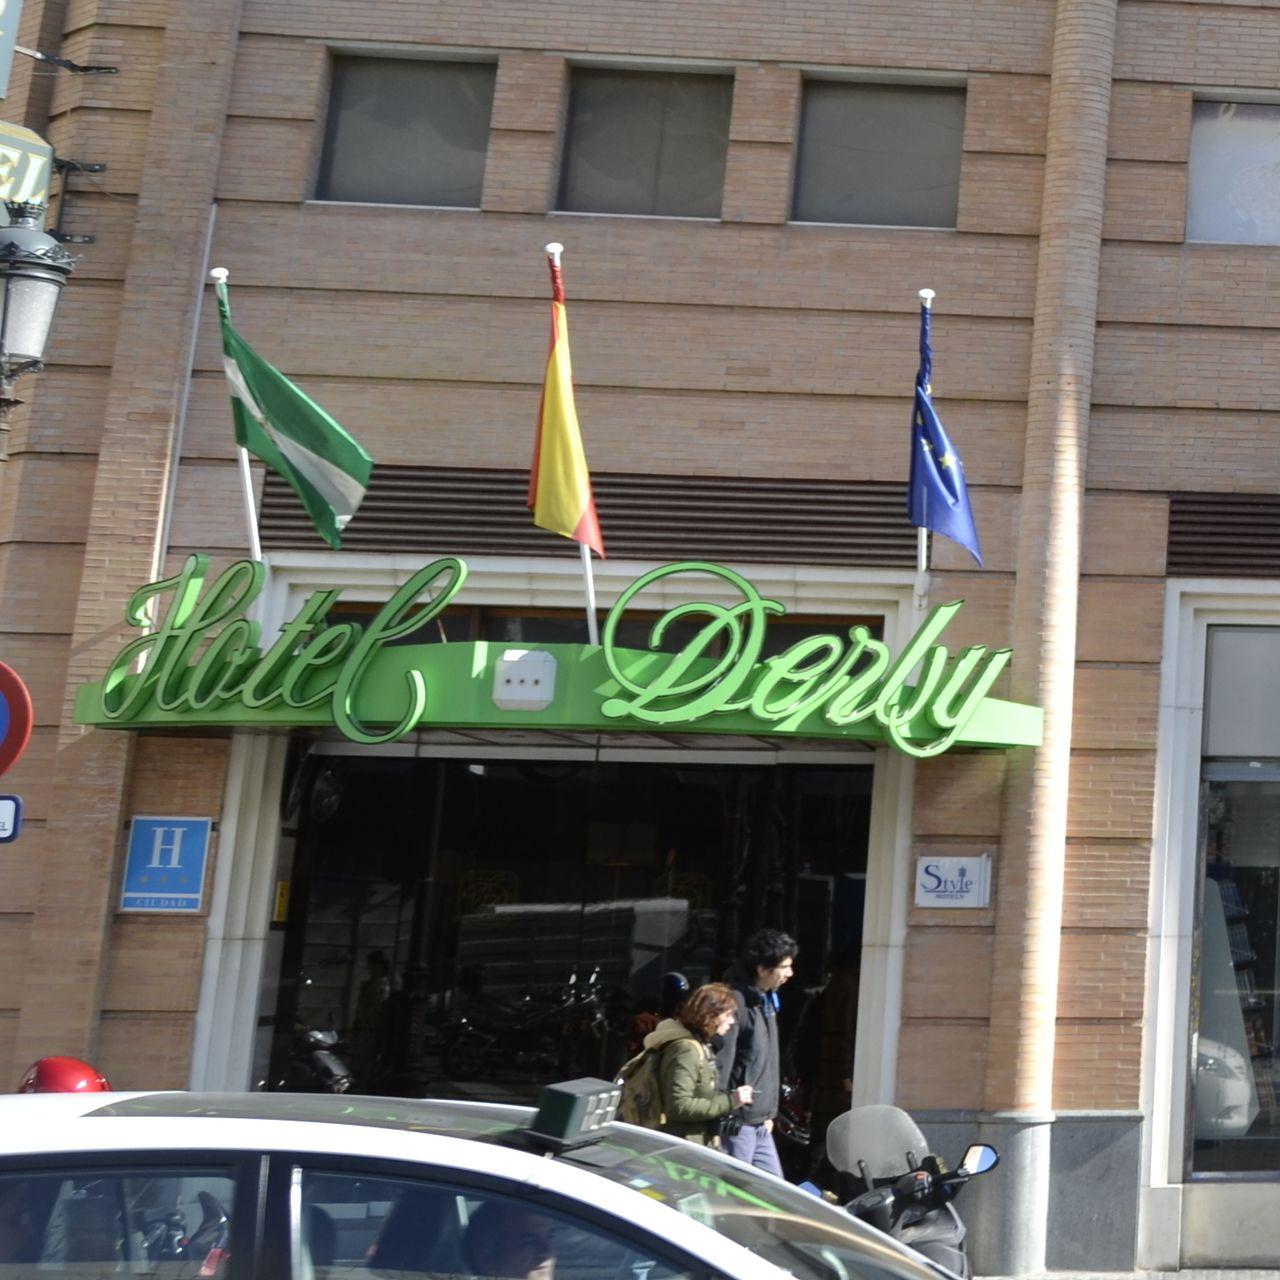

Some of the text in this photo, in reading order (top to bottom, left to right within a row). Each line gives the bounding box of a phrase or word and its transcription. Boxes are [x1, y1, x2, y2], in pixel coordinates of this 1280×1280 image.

[101, 553, 1011, 758] Hotel Derby
[920, 864, 974, 893] Style
